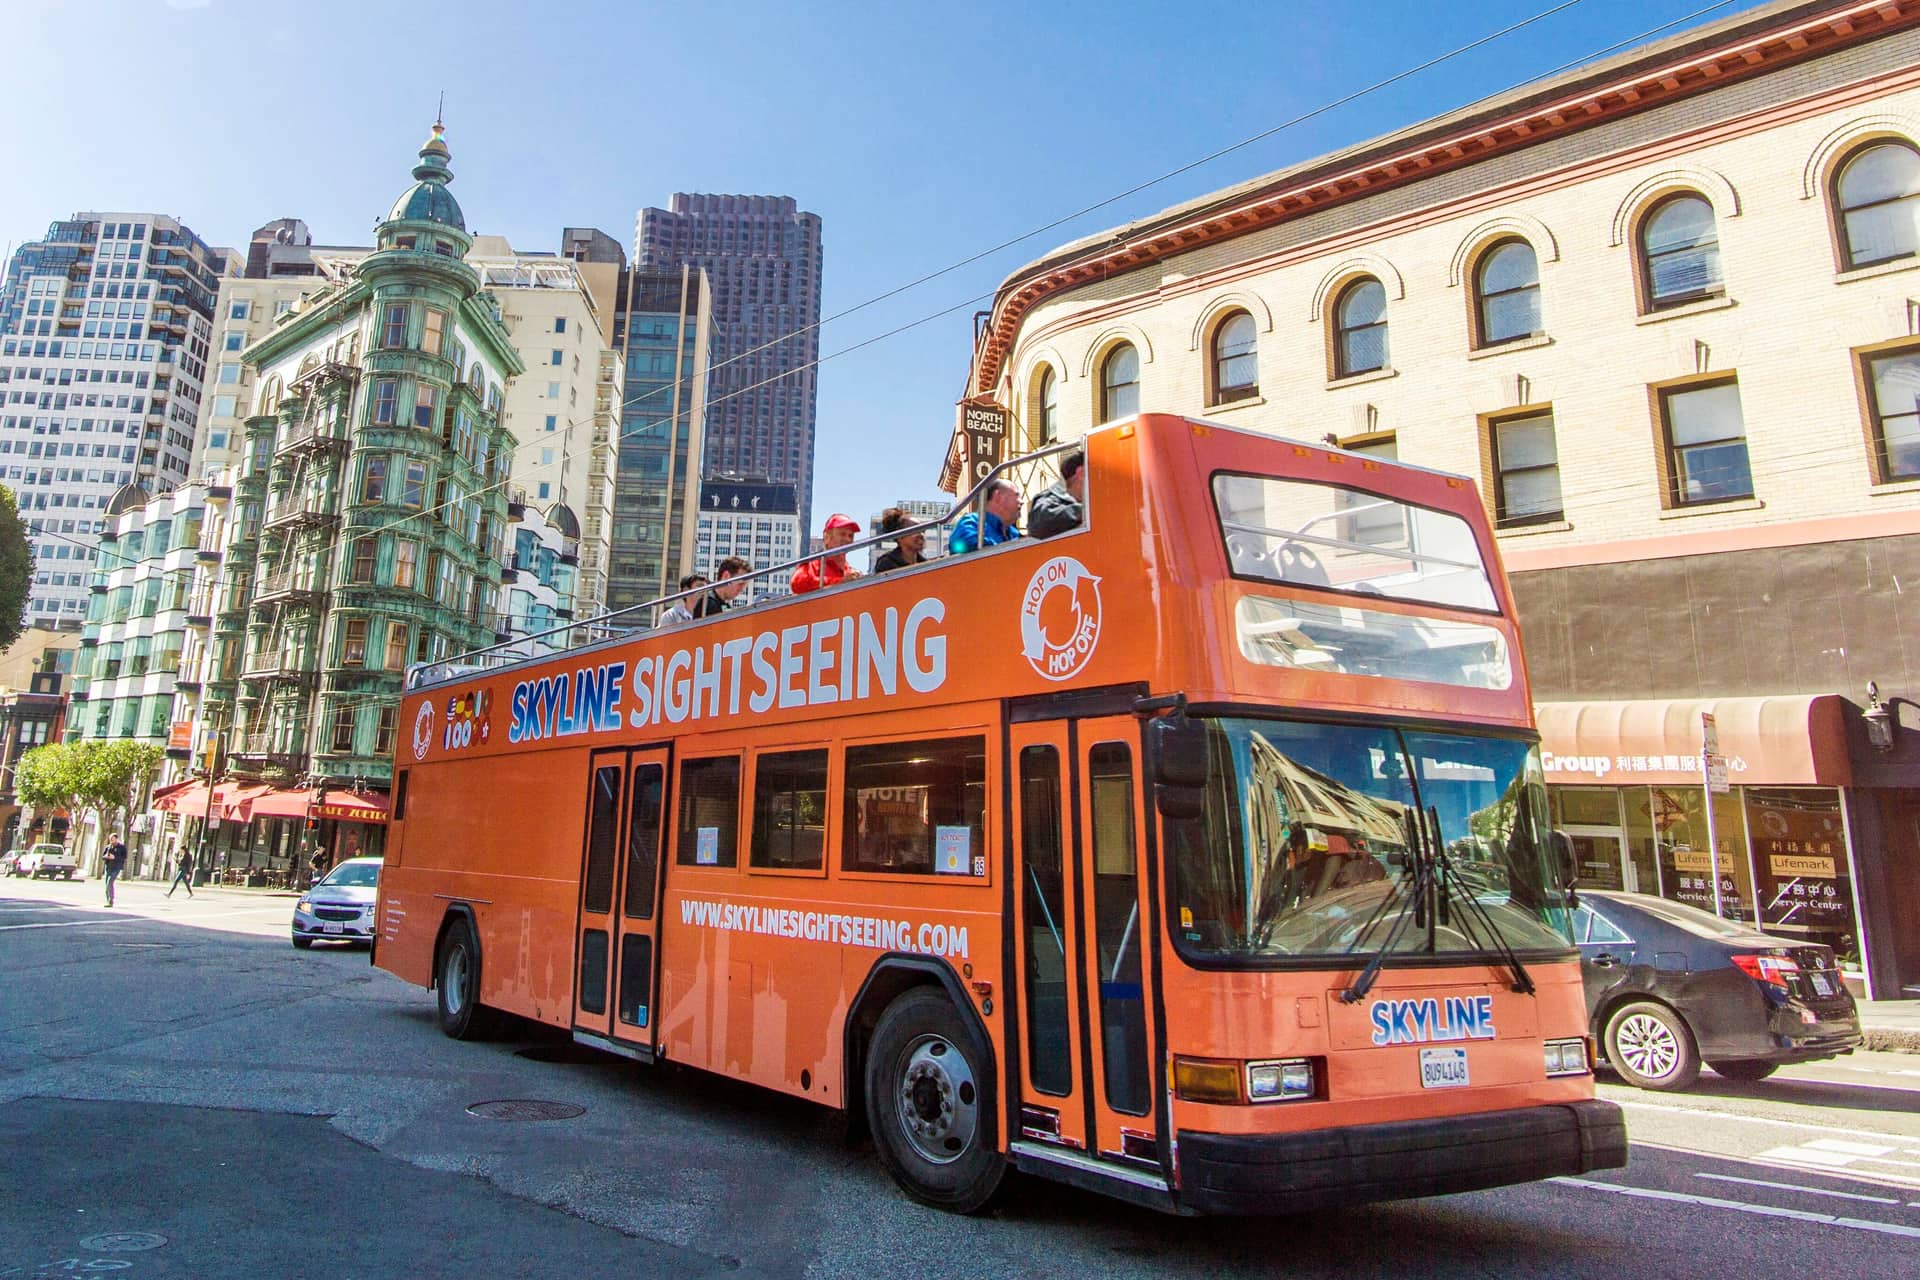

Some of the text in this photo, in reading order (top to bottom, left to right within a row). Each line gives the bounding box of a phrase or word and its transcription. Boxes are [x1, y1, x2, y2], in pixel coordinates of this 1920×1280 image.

[967, 409, 1003, 424] NORTH
[967, 420, 1003, 434] BEACH
[1026, 561, 1067, 616] HOP ON
[1048, 614, 1097, 673] HOP OFF
[509, 662, 626, 743] SKYLINE
[630, 597, 947, 727] SIGHTSEEING
[1540, 752, 1747, 776] Group 利福集團服心
[1678, 854, 1729, 865] Lifemrk
[1775, 858, 1830, 870] Lifemark
[975, 861, 984, 874] 35
[1676, 890, 1740, 904] Service Cnter
[1809, 899, 1843, 911] Center
[681, 900, 968, 958] WWW.SKYLINESIGHTSEEING.COM
[1371, 996, 1497, 1046] SKYLINE
